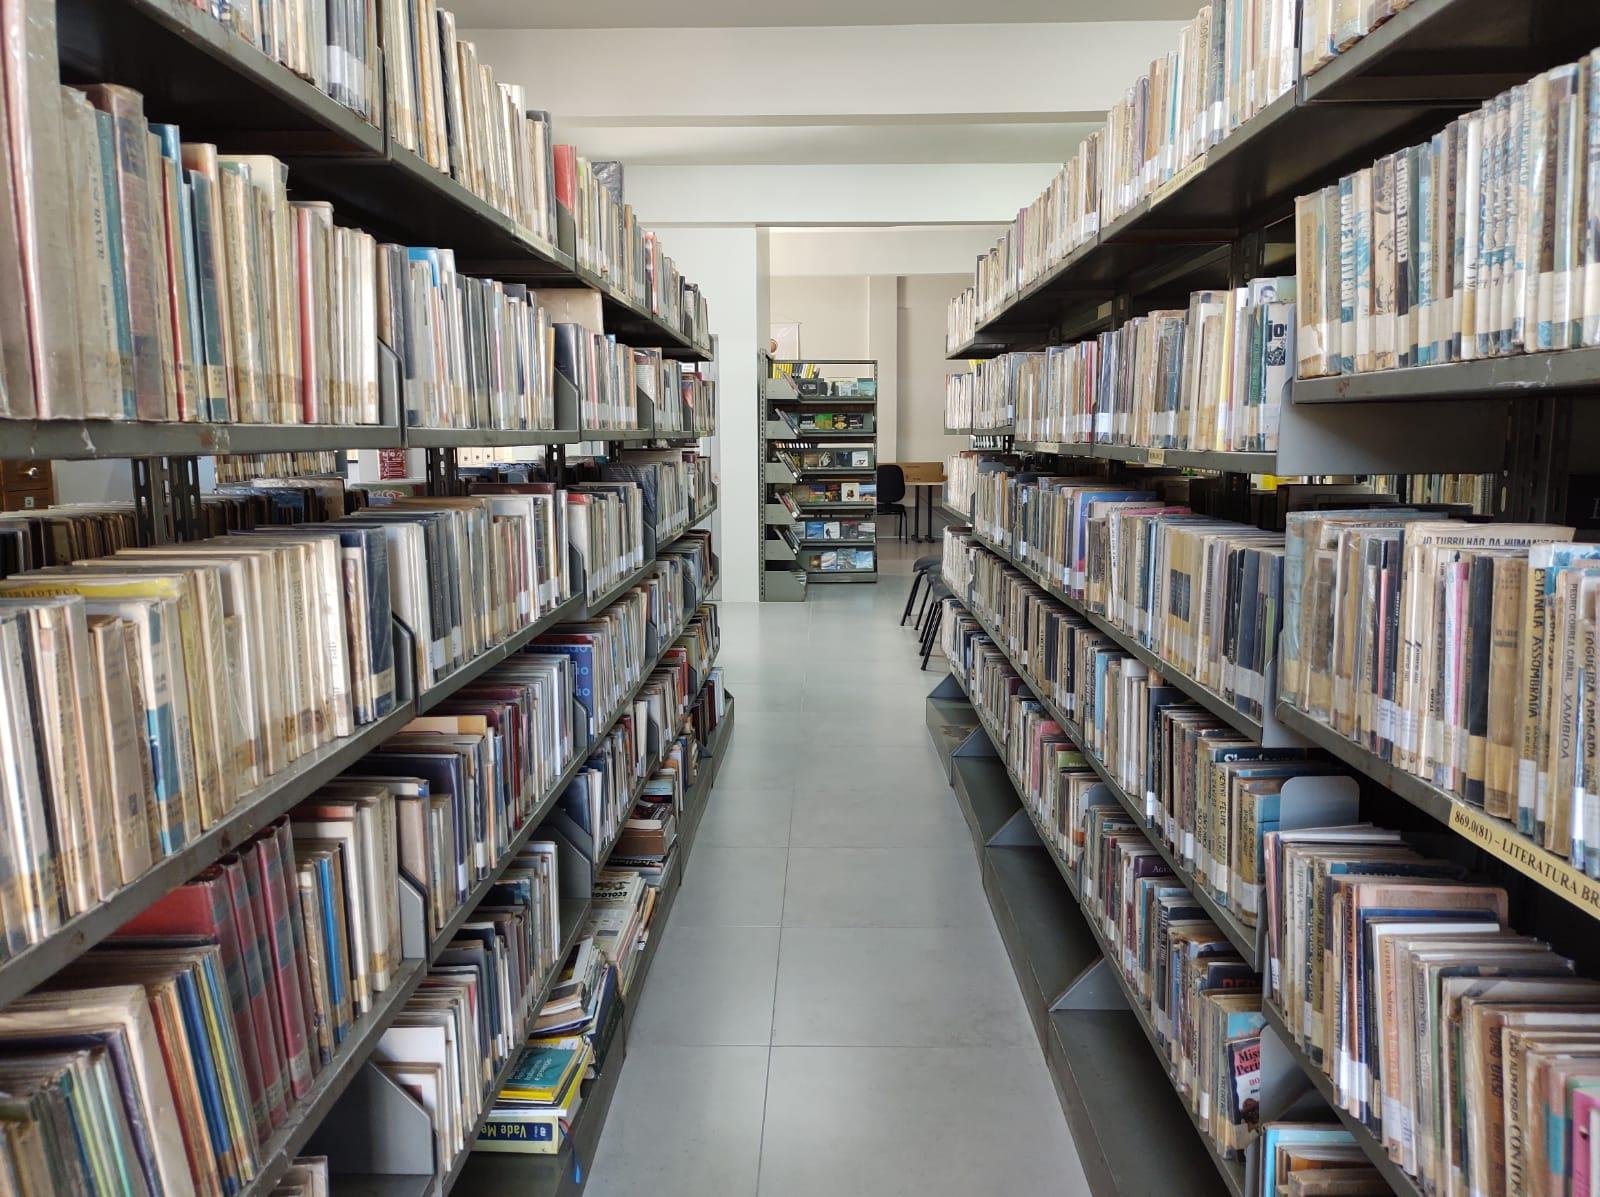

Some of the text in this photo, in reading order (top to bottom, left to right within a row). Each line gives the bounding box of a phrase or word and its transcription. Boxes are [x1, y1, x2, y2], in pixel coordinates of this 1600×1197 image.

[1568, 583, 1578, 611] PEDRO
[1566, 614, 1577, 647] CORREA
[1529, 636, 1542, 718] ASSOMBRADA
[1564, 649, 1575, 682] CABRAL
[1585, 631, 1595, 694] FOGUEIRA
[1585, 699, 1596, 758] APAGADA
[1454, 810, 1492, 844] 869.0(81)
[1502, 838, 1577, 894] LITERATURA
[1582, 885, 1600, 908] BR
[479, 1124, 527, 1139] Vade Me
